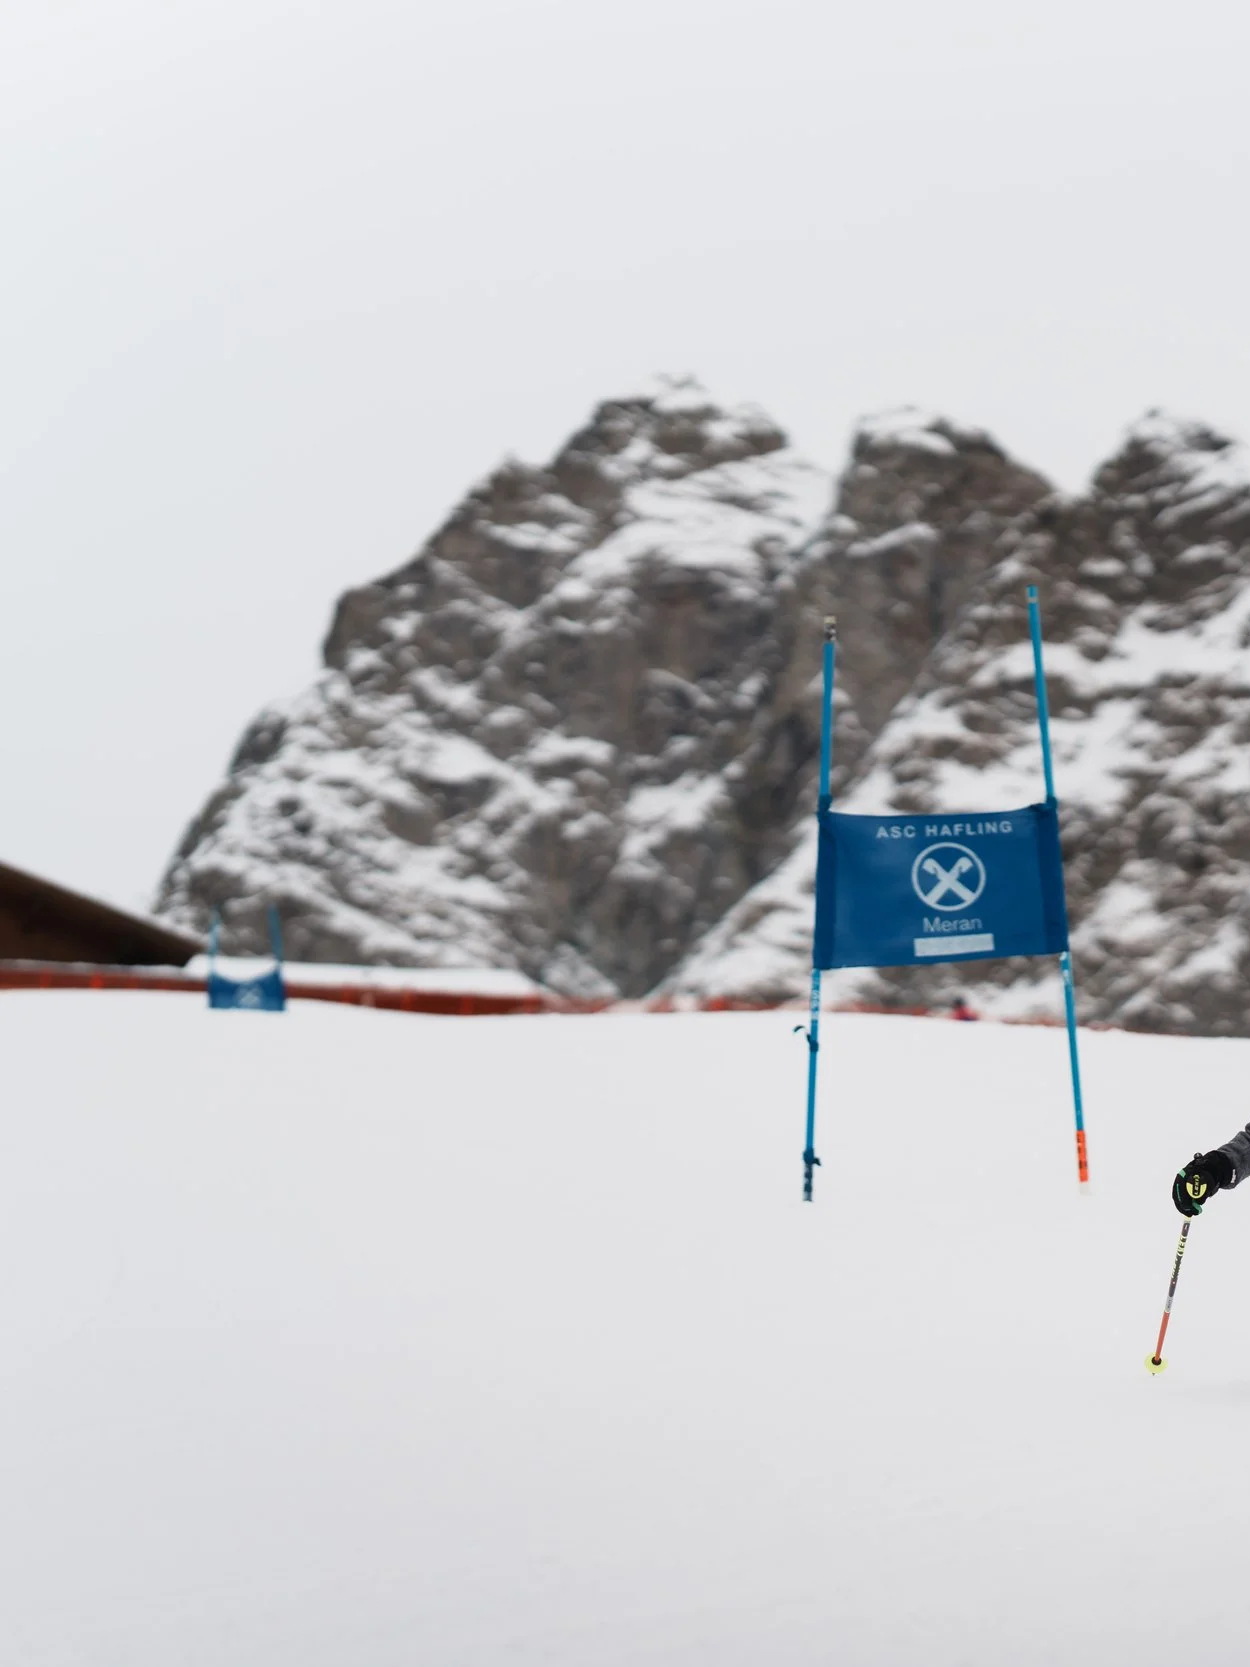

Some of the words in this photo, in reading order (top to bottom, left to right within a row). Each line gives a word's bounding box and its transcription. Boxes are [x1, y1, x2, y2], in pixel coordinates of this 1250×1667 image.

[875, 825, 916, 839] ASC
[925, 820, 1014, 837] HAFLING
[922, 917, 983, 933] Meran
